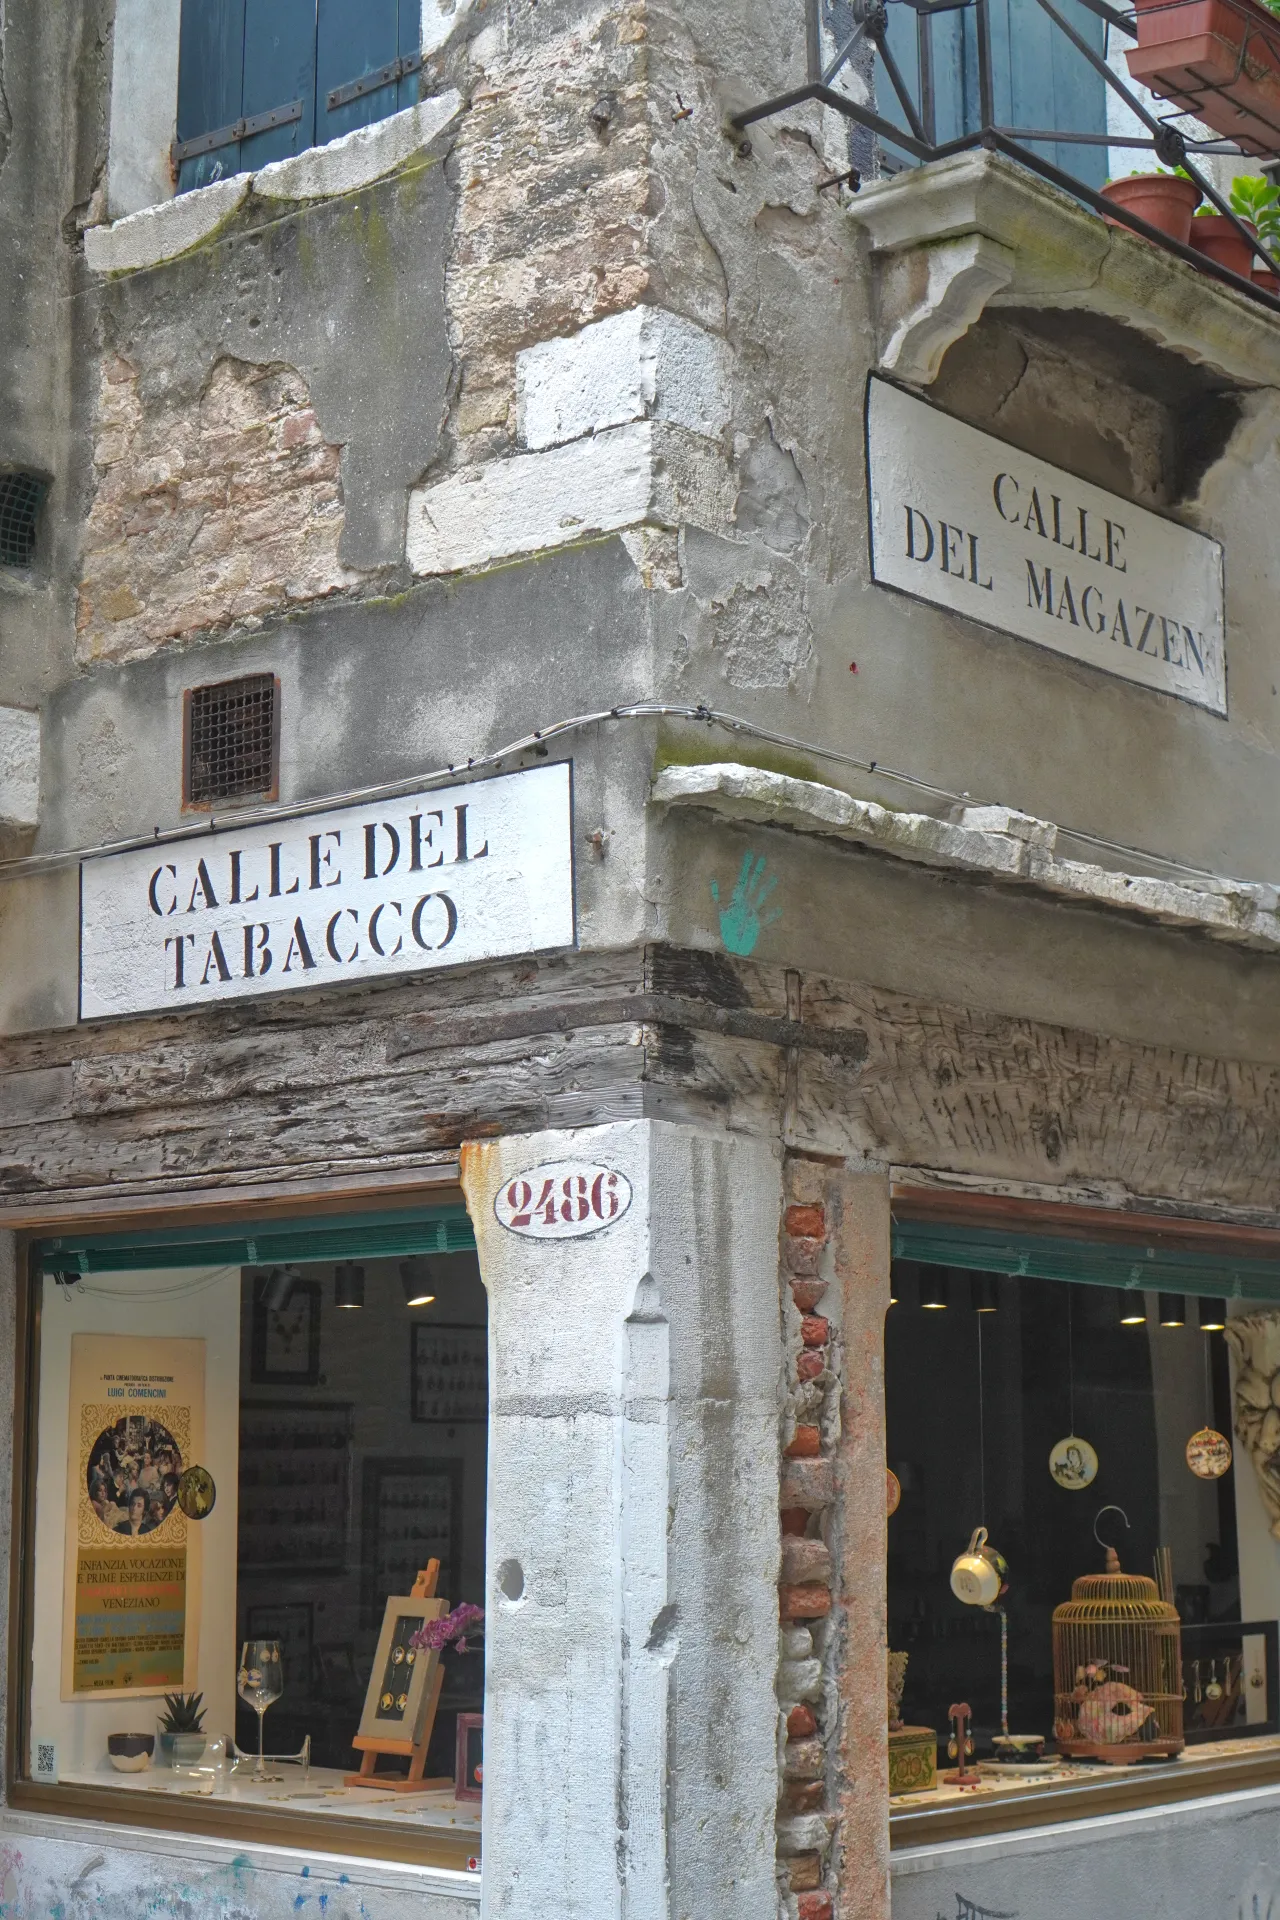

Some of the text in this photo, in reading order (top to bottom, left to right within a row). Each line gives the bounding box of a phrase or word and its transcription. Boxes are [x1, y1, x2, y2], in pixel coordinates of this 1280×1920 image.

[903, 504, 993, 591] DEL
[993, 472, 1127, 574] CALLE
[148, 803, 489, 917] CALLE DEL
[164, 892, 459, 989] TABACCO
[507, 1172, 619, 1227] 2486
[107, 1388, 167, 1398] LUIGI COMENCINI
[77, 1571, 185, 1584] E PRIME ESPERIENZE DI
[129, 1558, 184, 1569] VOCAZIONE
[102, 1597, 160, 1609] VENEZIANO
